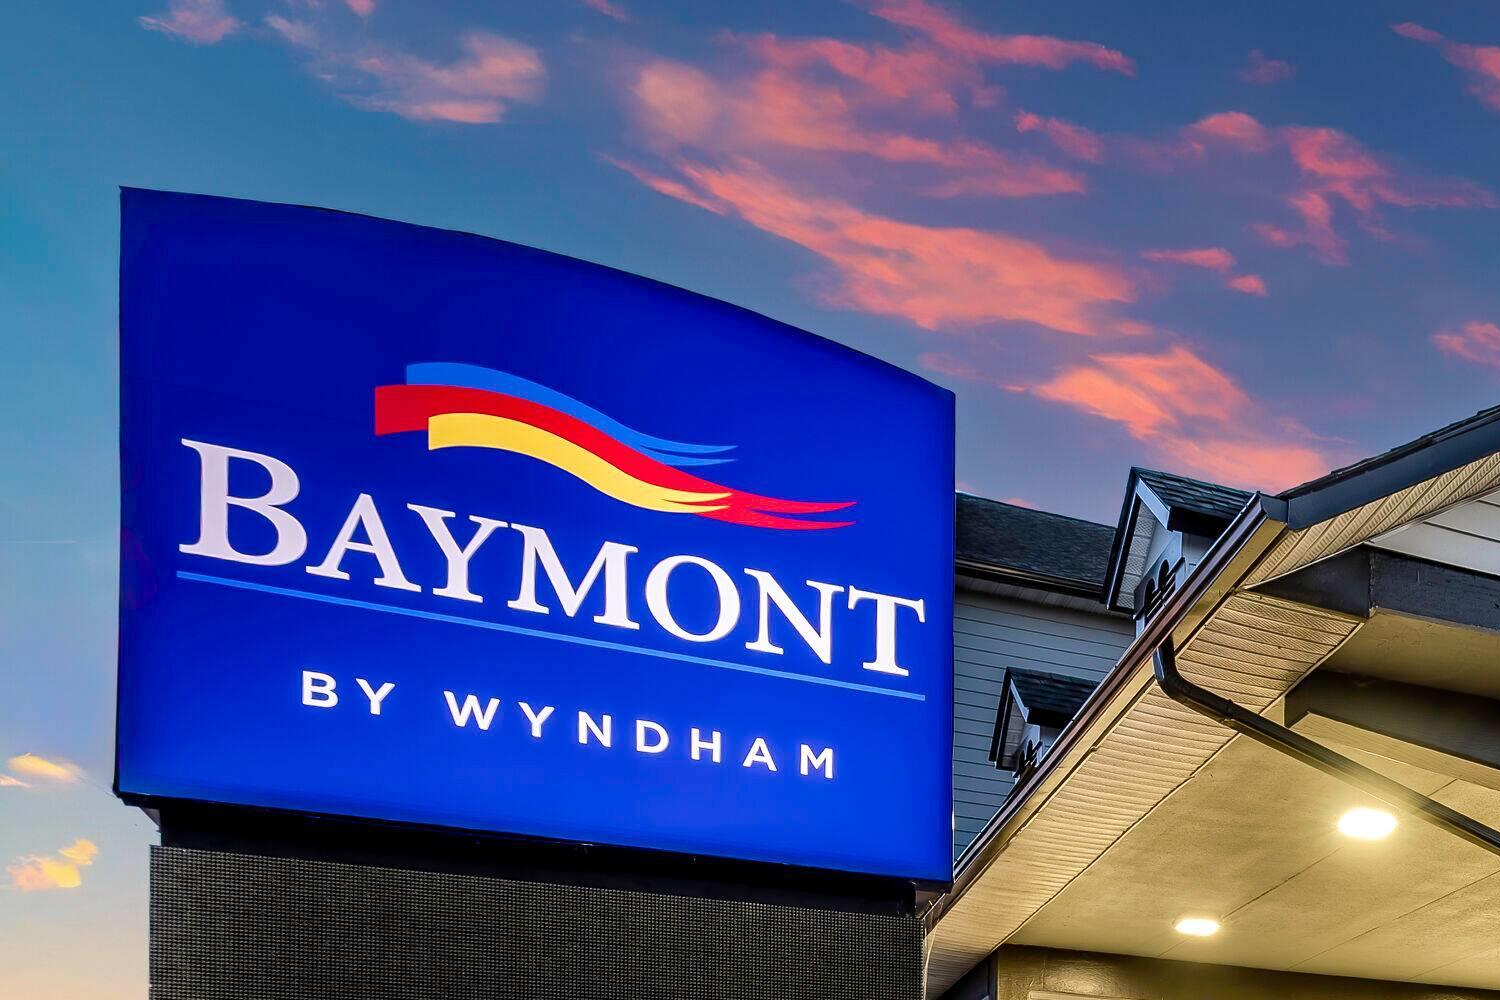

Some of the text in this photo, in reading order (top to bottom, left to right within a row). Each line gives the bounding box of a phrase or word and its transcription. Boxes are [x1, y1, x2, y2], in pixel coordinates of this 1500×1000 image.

[178, 438, 926, 677] BAYMONT
[301, 670, 834, 779] BY WYNDHAM
